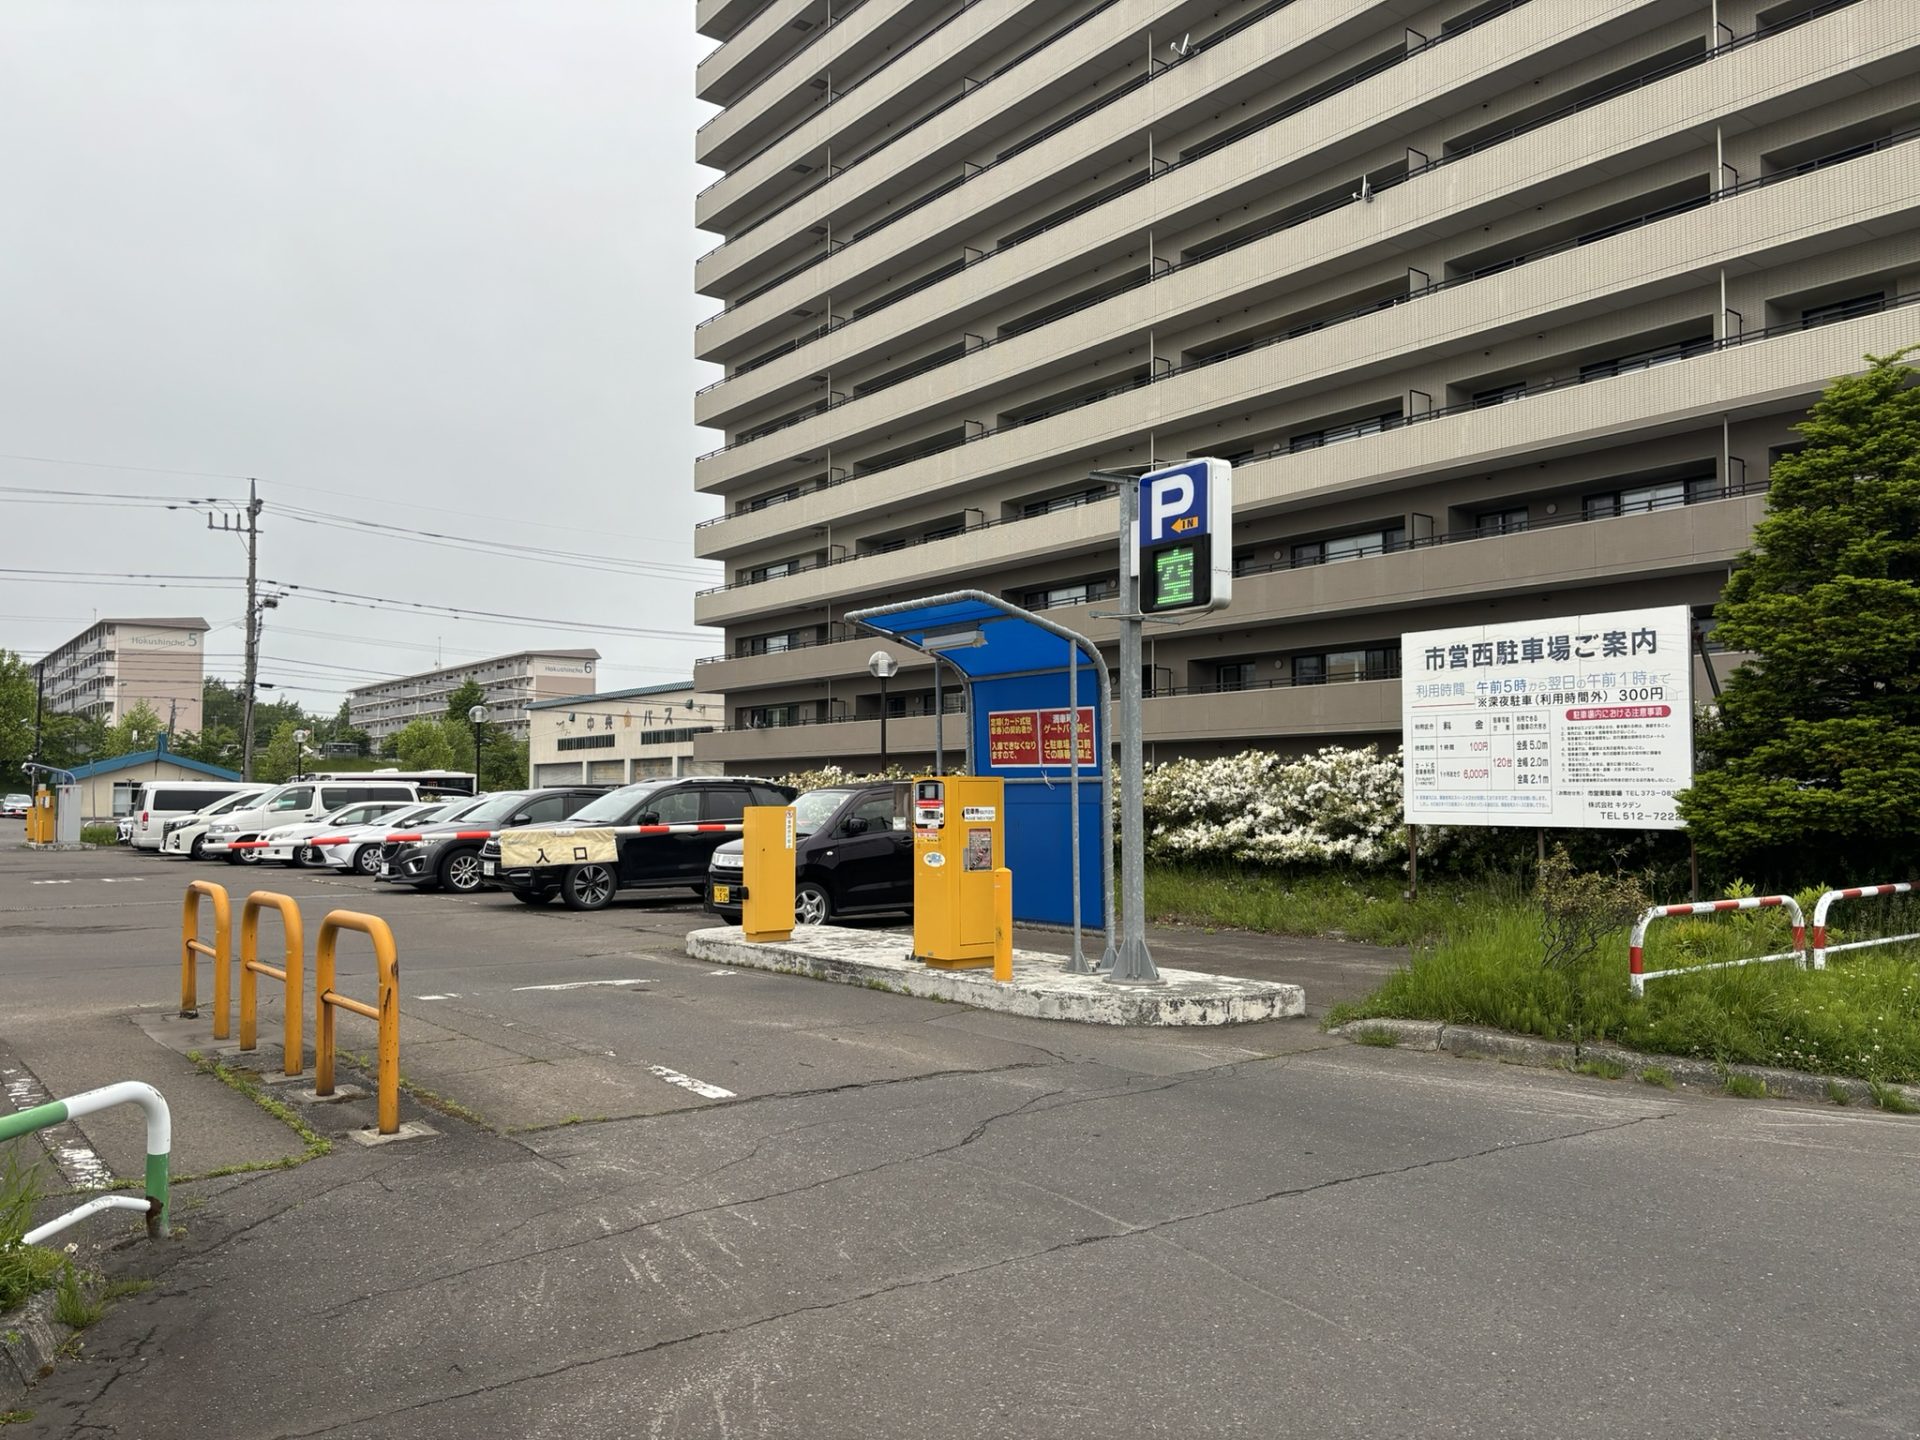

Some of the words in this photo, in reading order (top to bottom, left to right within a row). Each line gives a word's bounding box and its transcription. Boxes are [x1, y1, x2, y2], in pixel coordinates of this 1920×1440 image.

[1151, 473, 1195, 541] P
[1182, 519, 1194, 529] IN
[1157, 549, 1194, 605] 空
[131, 636, 186, 647] Hokushincho
[188, 632, 198, 647] 5
[1424, 627, 1657, 671] 市営西駐車場ご案内
[584, 661, 593, 674] 6
[1416, 682, 1466, 699] 利用時間
[1619, 686, 1664, 702] 300円
[587, 713, 613, 731] 中央
[643, 707, 673, 727] バス
[1469, 741, 1489, 752] 100円
[1493, 757, 1513, 768] 120台
[1463, 769, 1489, 780] 6,000円
[1588, 801, 1614, 809] 株式会社
[1600, 811, 1621, 820] TEL
[536, 846, 588, 864] 入口
